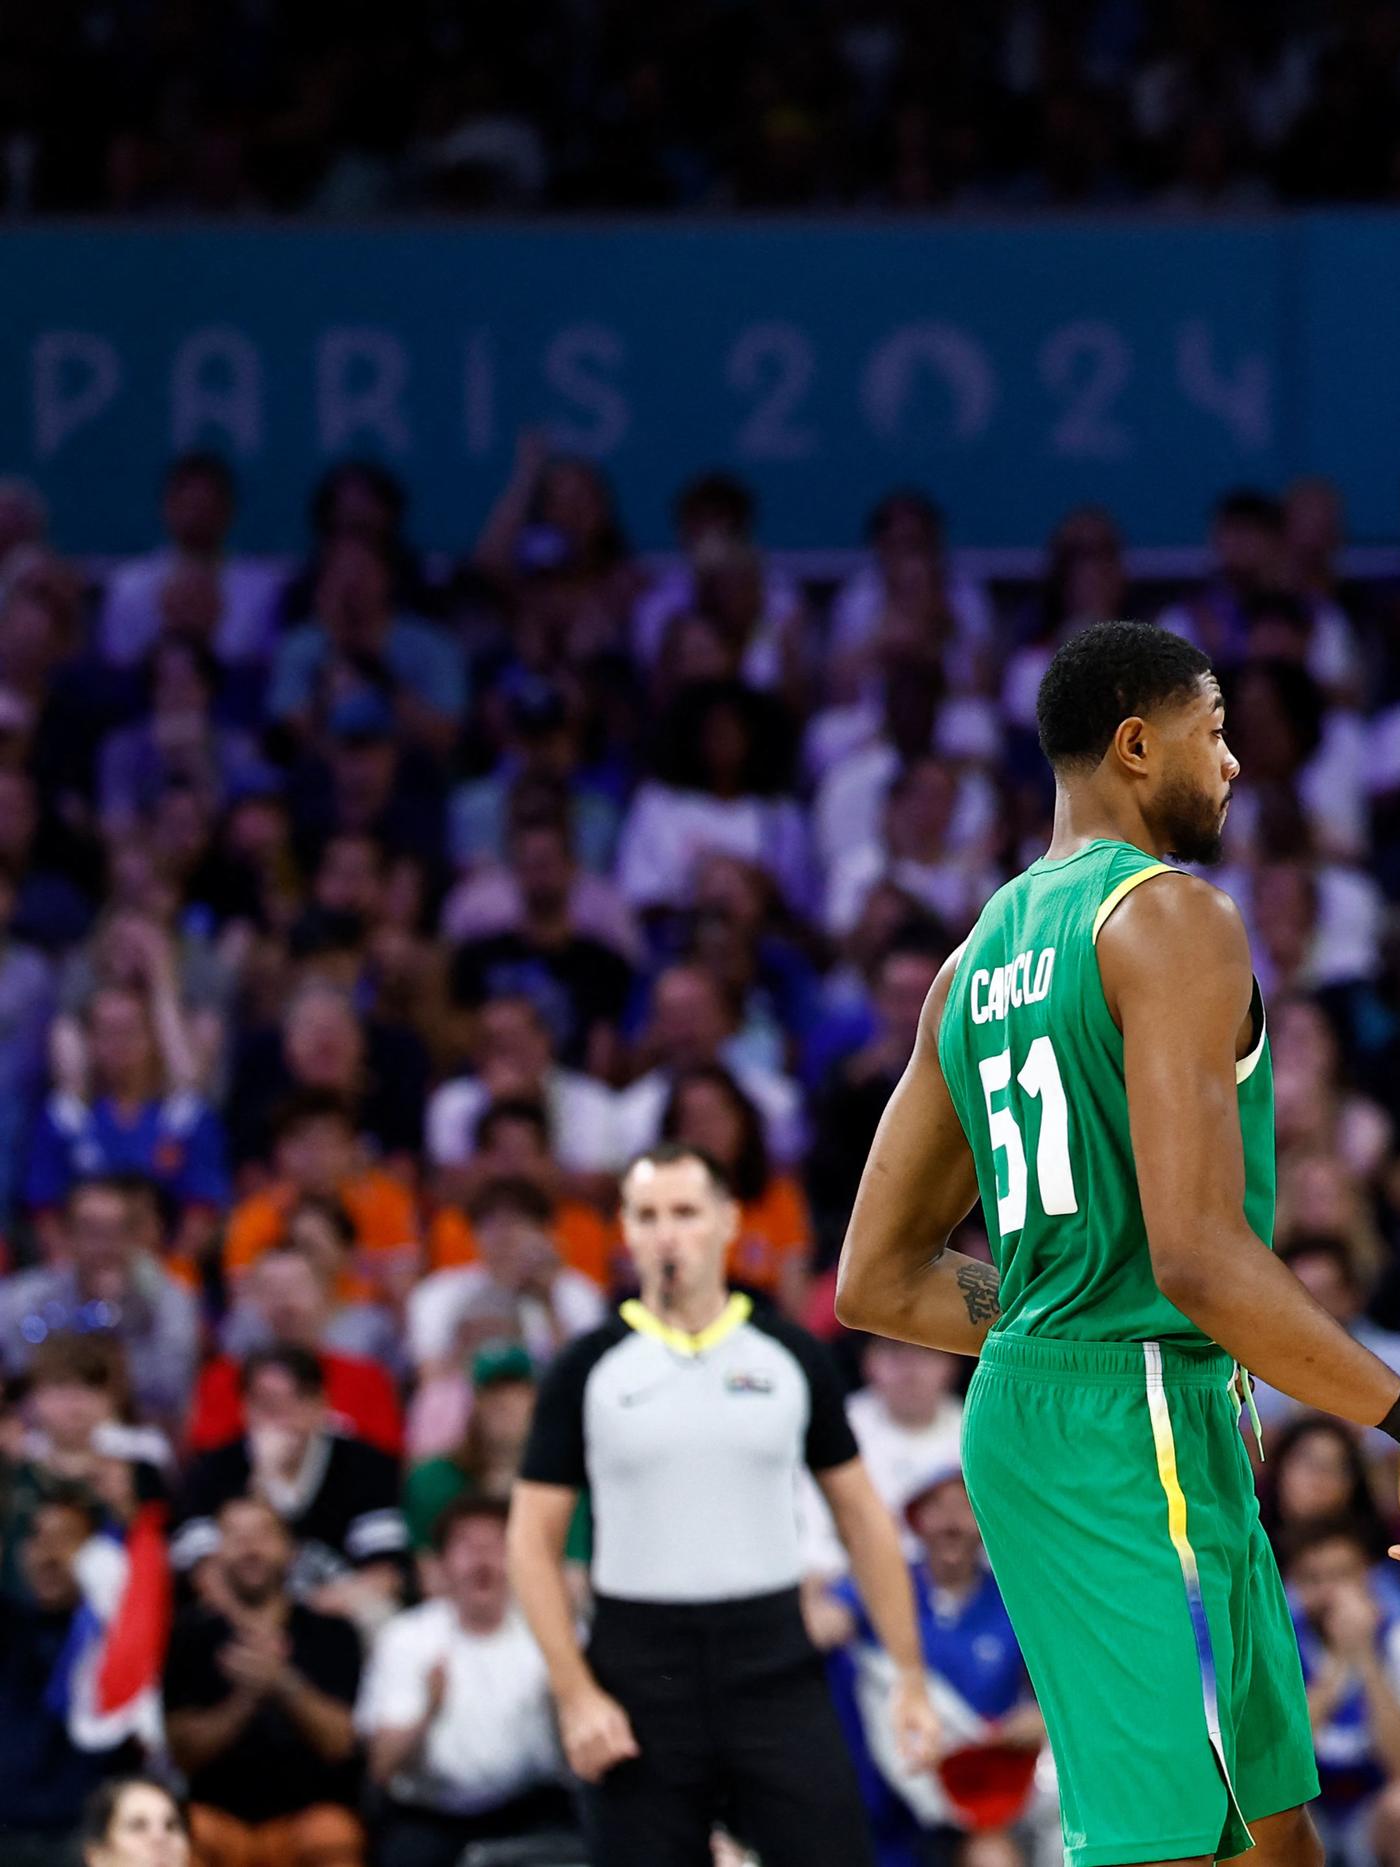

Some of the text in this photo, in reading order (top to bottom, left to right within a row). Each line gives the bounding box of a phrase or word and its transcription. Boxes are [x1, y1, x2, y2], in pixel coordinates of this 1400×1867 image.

[27, 317, 1275, 463] PARIS 2024
[978, 1035, 1079, 1237] 51
